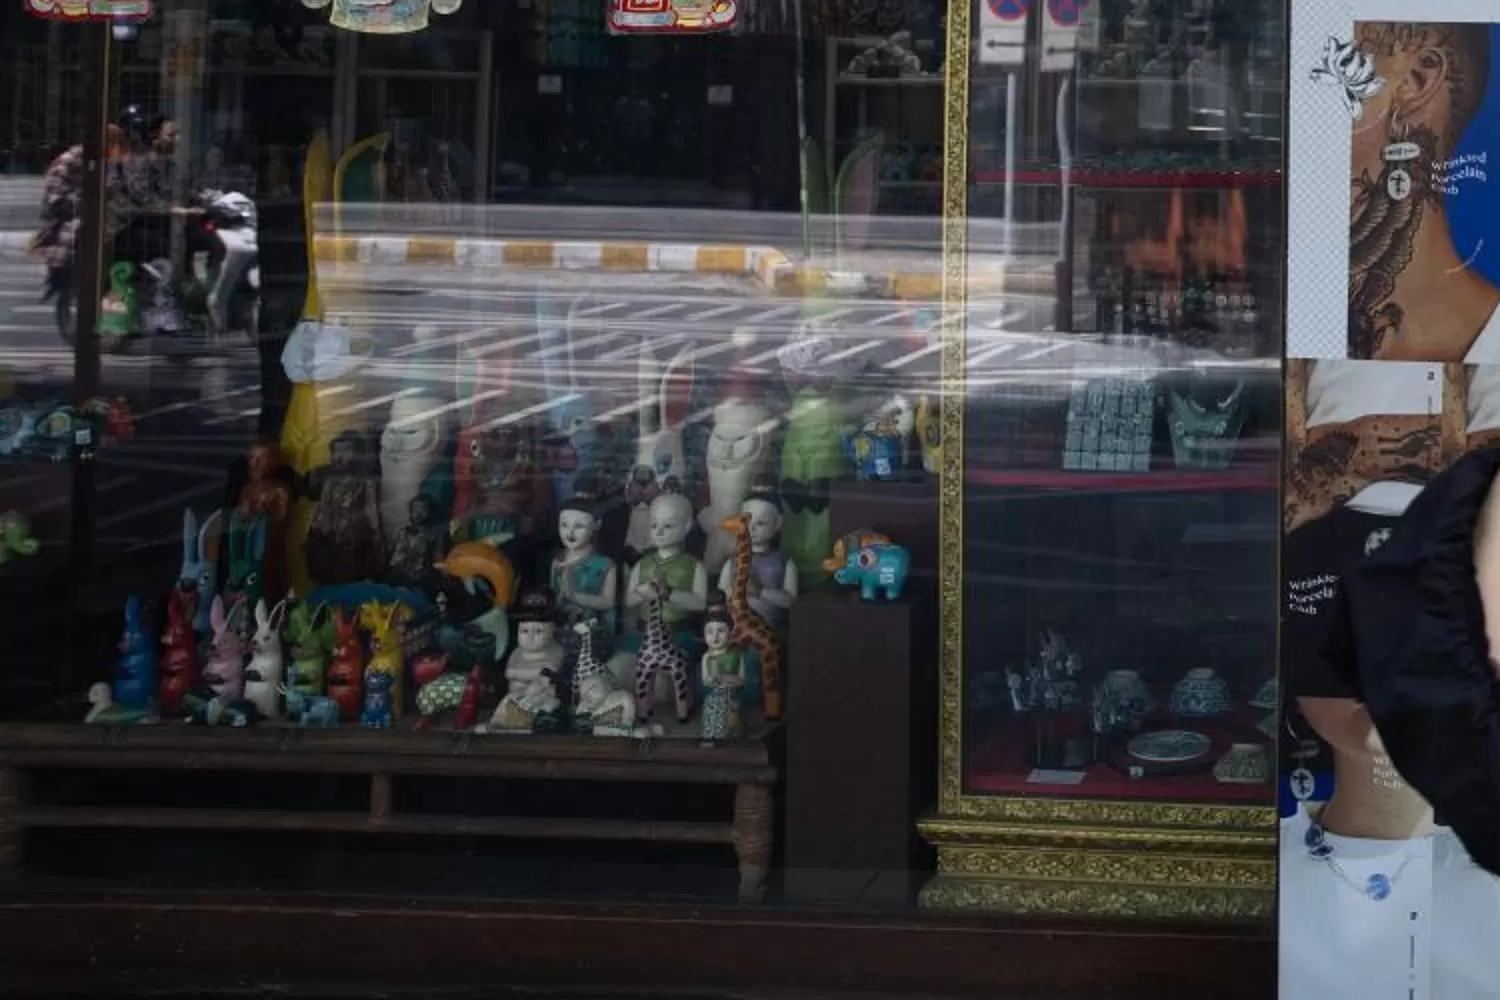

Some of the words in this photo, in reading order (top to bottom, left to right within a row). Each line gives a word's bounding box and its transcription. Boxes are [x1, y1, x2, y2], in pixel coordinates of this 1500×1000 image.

[1431, 151, 1487, 171] Wrinkled
[1431, 163, 1488, 184] Porcelain
[1289, 573, 1340, 591] Wrinkle
[1289, 603, 1318, 616] Club
